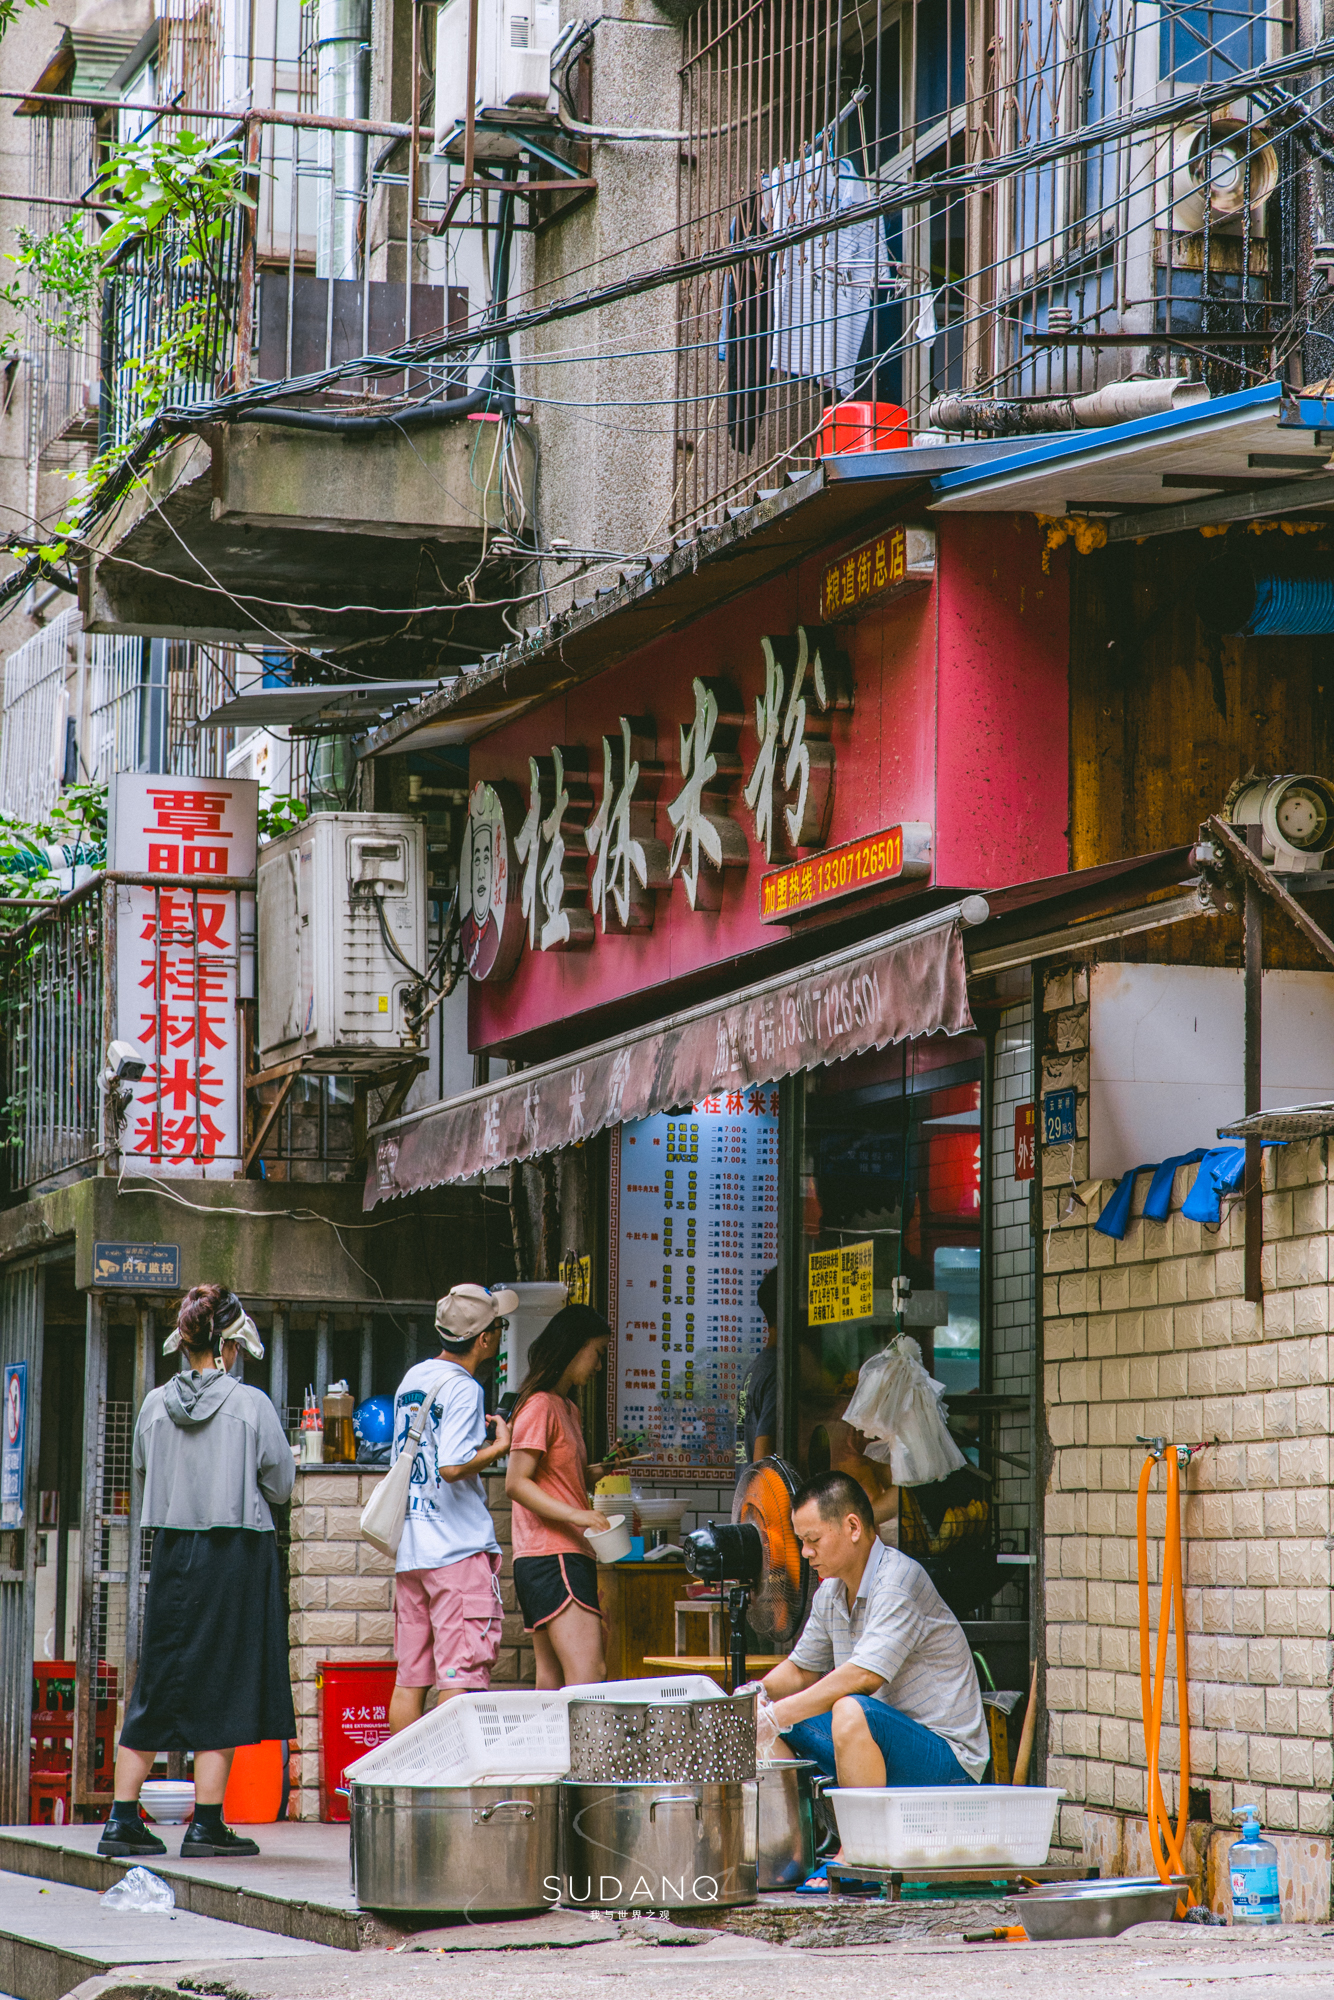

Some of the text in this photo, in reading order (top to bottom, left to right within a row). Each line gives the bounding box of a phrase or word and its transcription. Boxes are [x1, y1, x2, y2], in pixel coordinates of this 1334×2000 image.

[826, 530, 904, 615] 粮道街总店
[513, 626, 828, 951] 桂林米粉
[763, 835, 901, 915] 加盟热线:13307126501
[133, 788, 233, 1165] 覃肥叔桂林米粉
[712, 970, 883, 1077] 加盟电话:13307126501
[483, 1048, 631, 1158] 桂林米粉
[692, 1089, 779, 1117] 桂林米
[712, 1126, 747, 1134] 二两7.00元
[1048, 1117, 1061, 1140] 29
[712, 1136, 747, 1144] 二两7.00元
[711, 1146, 746, 1154] 二两7.00元
[711, 1156, 746, 1164] 二两7.00元
[710, 1173, 745, 1181] 二两18.0元
[708, 1220, 744, 1228] 二两18.0元
[123, 1261, 174, 1274] 内有监控
[812, 1269, 838, 1288] 本店外卖只有
[707, 1288, 743, 1296] 二两18.0元
[810, 1286, 839, 1305] 饿了么平台下单
[707, 1298, 743, 1306] 二两18.0元
[814, 1304, 835, 1320] 只有饿了么
[626, 1321, 657, 1330] 广西特色
[707, 1325, 742, 1333] 二两18.0元
[707, 1335, 742, 1343] 二两18.0元
[706, 1362, 742, 1370] 二两18.0元
[625, 1368, 656, 1377] 广西特色
[667, 1453, 730, 1463] 6:00-21:00
[342, 1706, 386, 1721] 灭火器
